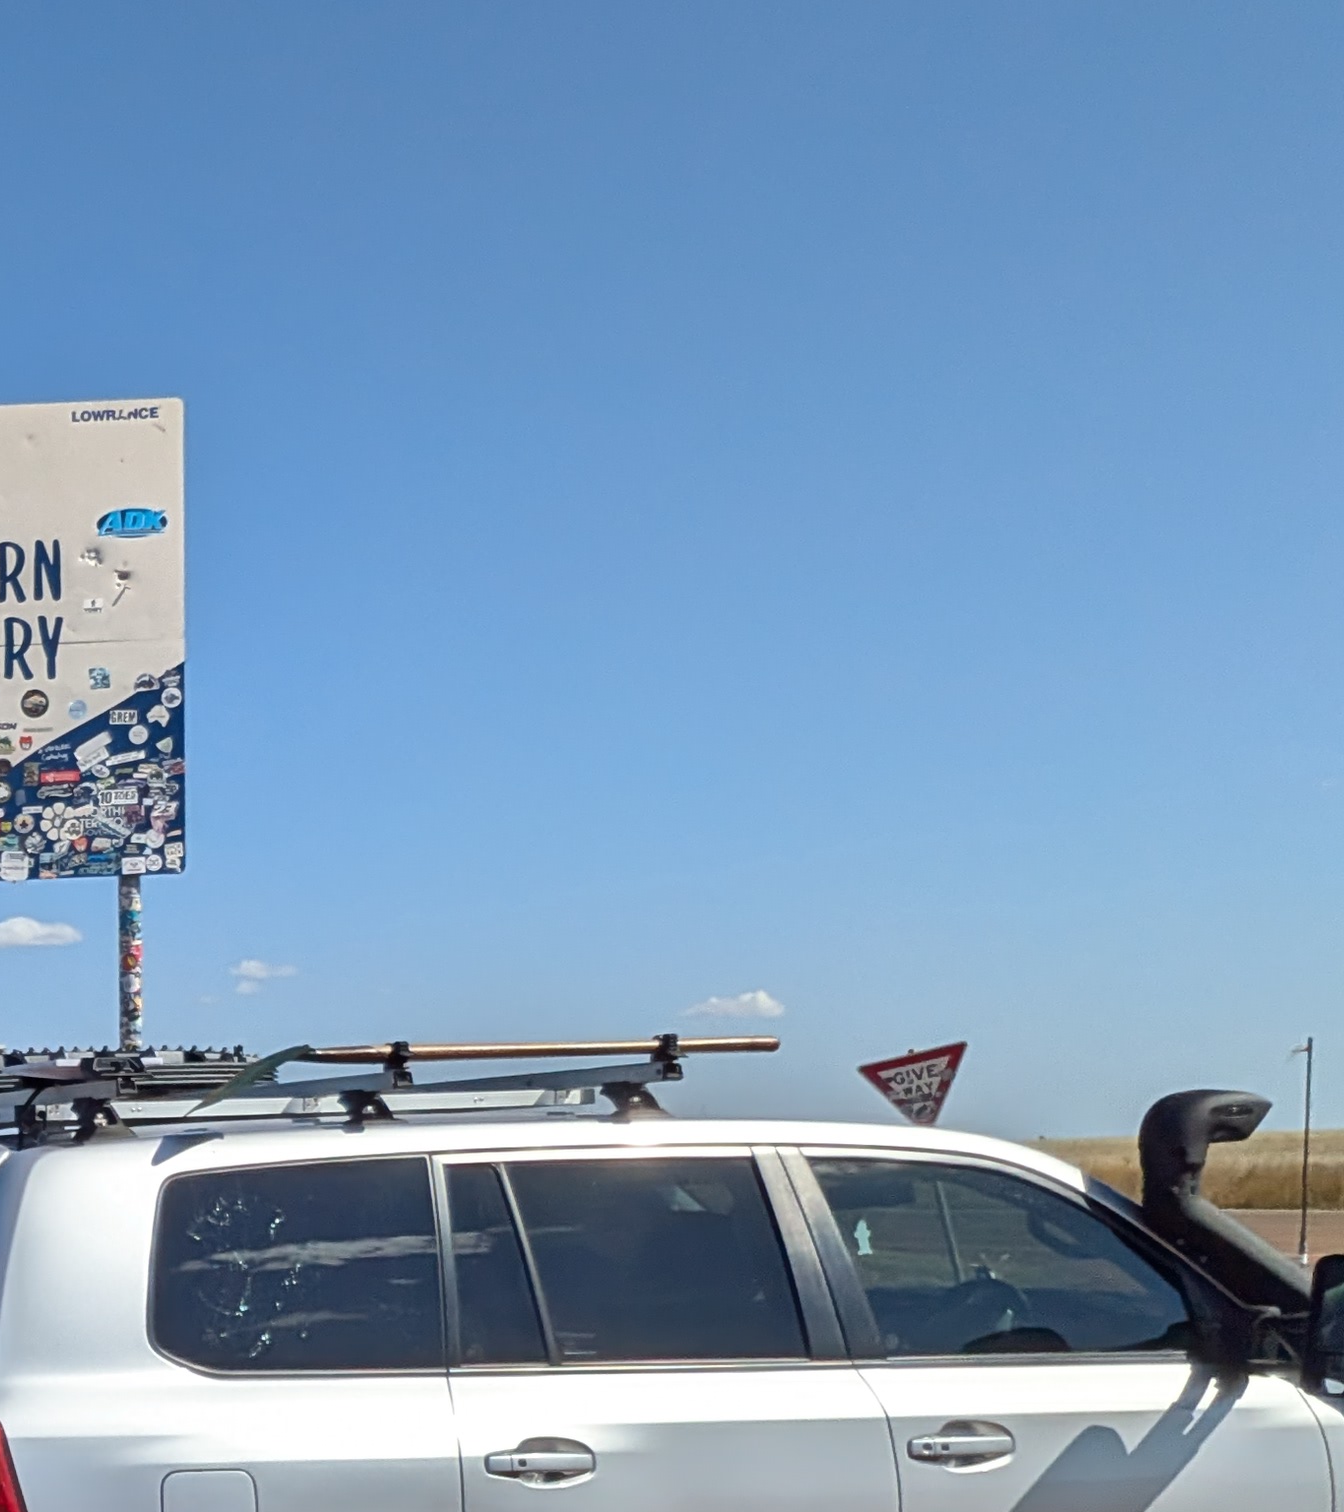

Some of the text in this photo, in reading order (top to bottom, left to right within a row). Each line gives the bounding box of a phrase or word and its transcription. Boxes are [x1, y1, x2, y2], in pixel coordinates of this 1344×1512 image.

[98, 509, 167, 537] ADK
[892, 1063, 938, 1085] GIVE
[902, 1080, 933, 1097] WAY
